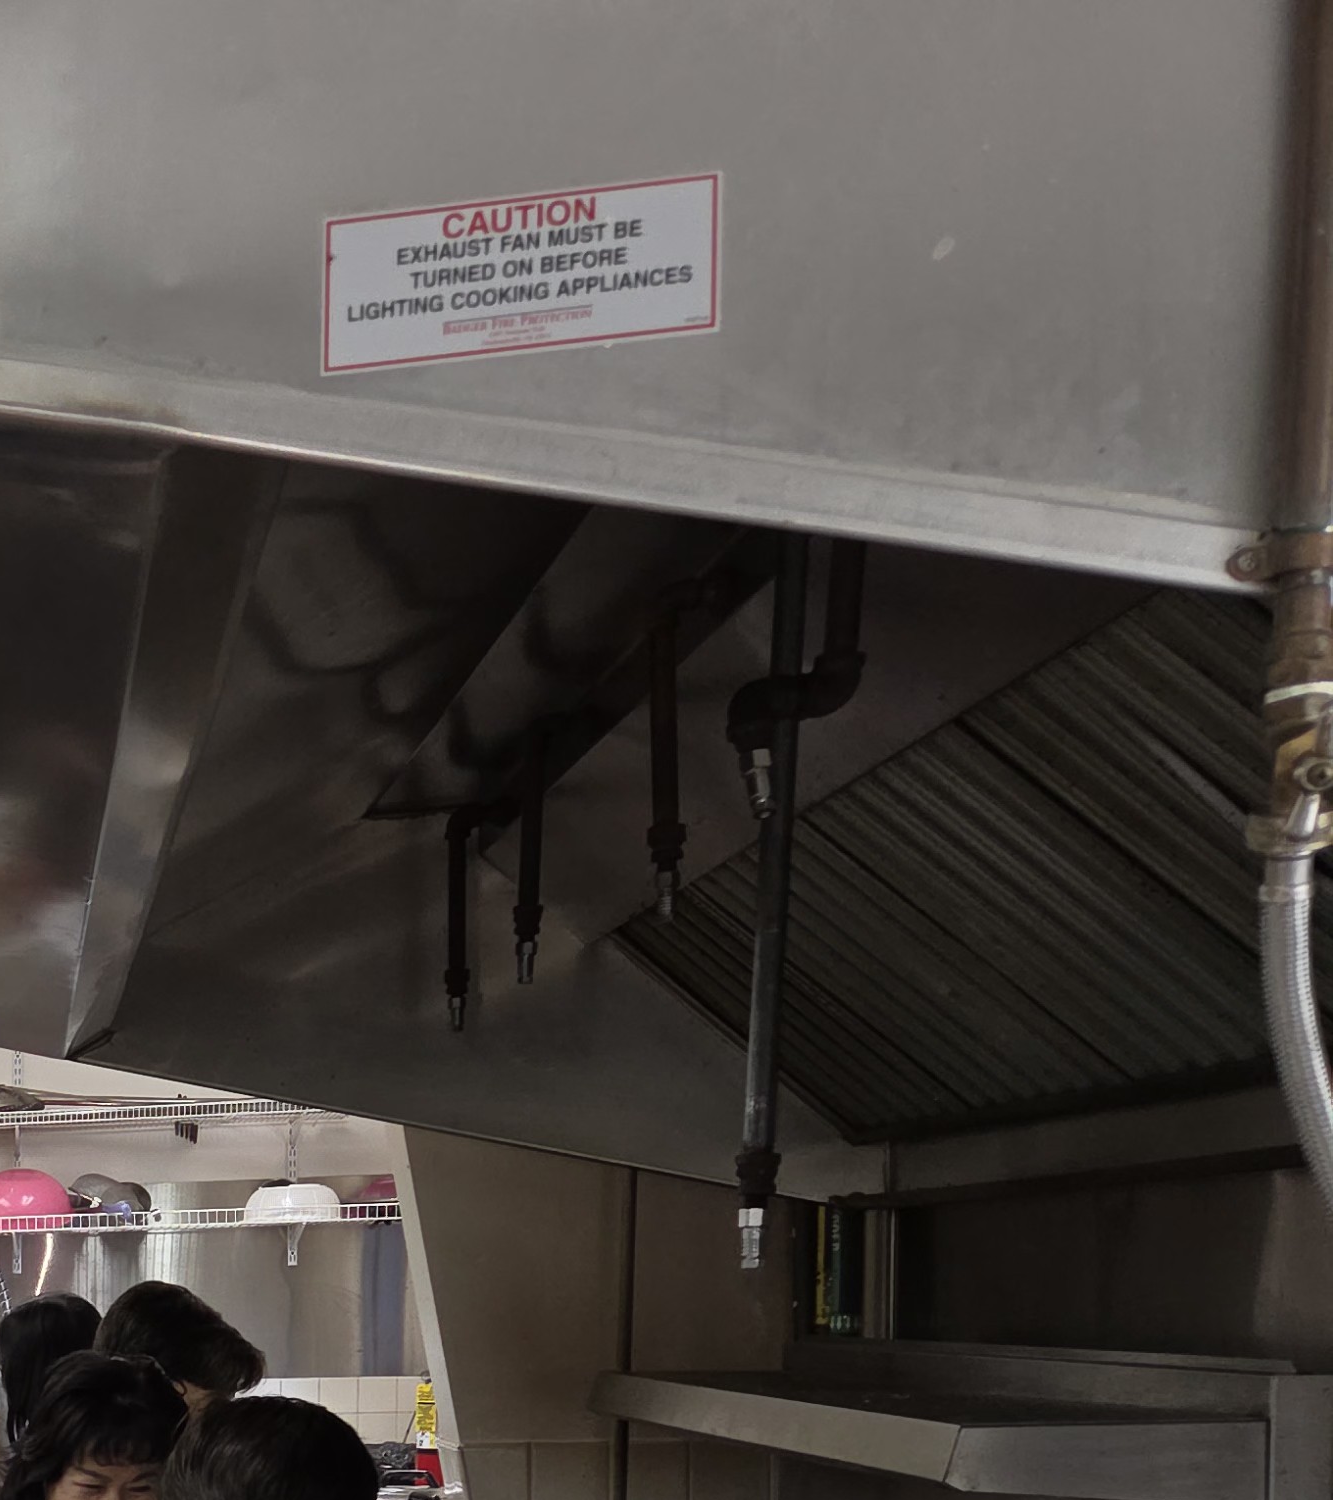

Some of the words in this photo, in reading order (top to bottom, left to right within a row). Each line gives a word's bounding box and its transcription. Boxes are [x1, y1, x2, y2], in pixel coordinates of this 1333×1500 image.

[442, 197, 597, 239] CAUTION
[396, 237, 494, 266] EXHAUST
[500, 234, 540, 252] FAN
[548, 223, 607, 248] MUST
[614, 220, 643, 238] BE
[410, 261, 496, 290] TURNED
[502, 258, 532, 278] ON
[540, 247, 628, 273] BEFORE
[347, 295, 444, 322] LIGHTING
[451, 282, 550, 311] COOKING
[556, 265, 693, 297] APPLIANCES
